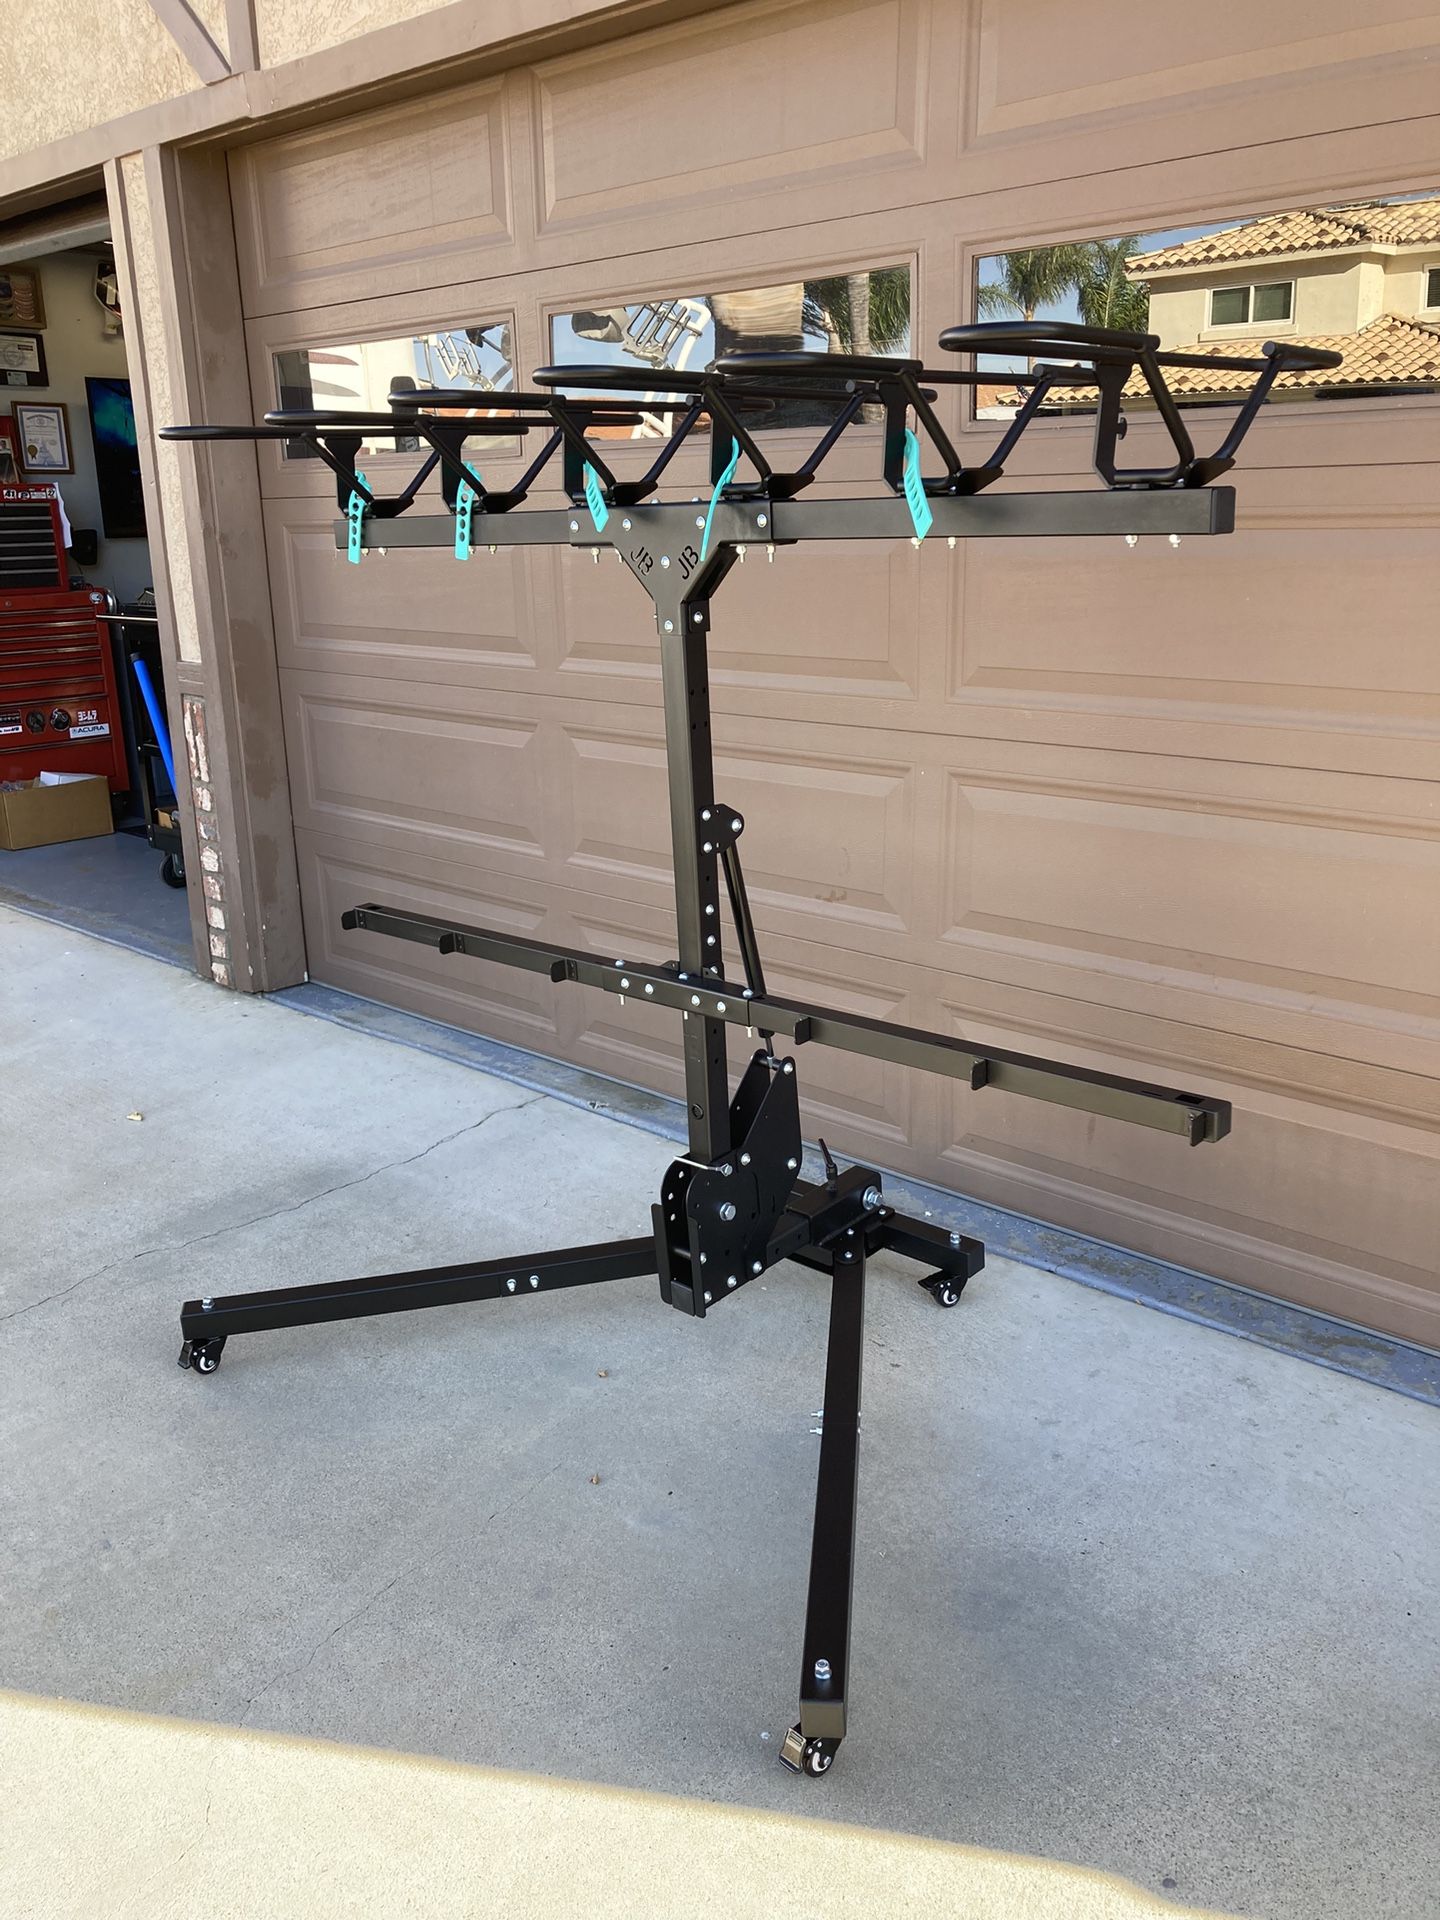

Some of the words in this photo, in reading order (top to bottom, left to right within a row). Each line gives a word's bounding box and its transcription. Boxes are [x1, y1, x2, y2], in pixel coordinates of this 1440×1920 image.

[630, 546, 654, 577] JB
[678, 545, 699, 580] JB
[77, 725, 105, 734] ACURA
